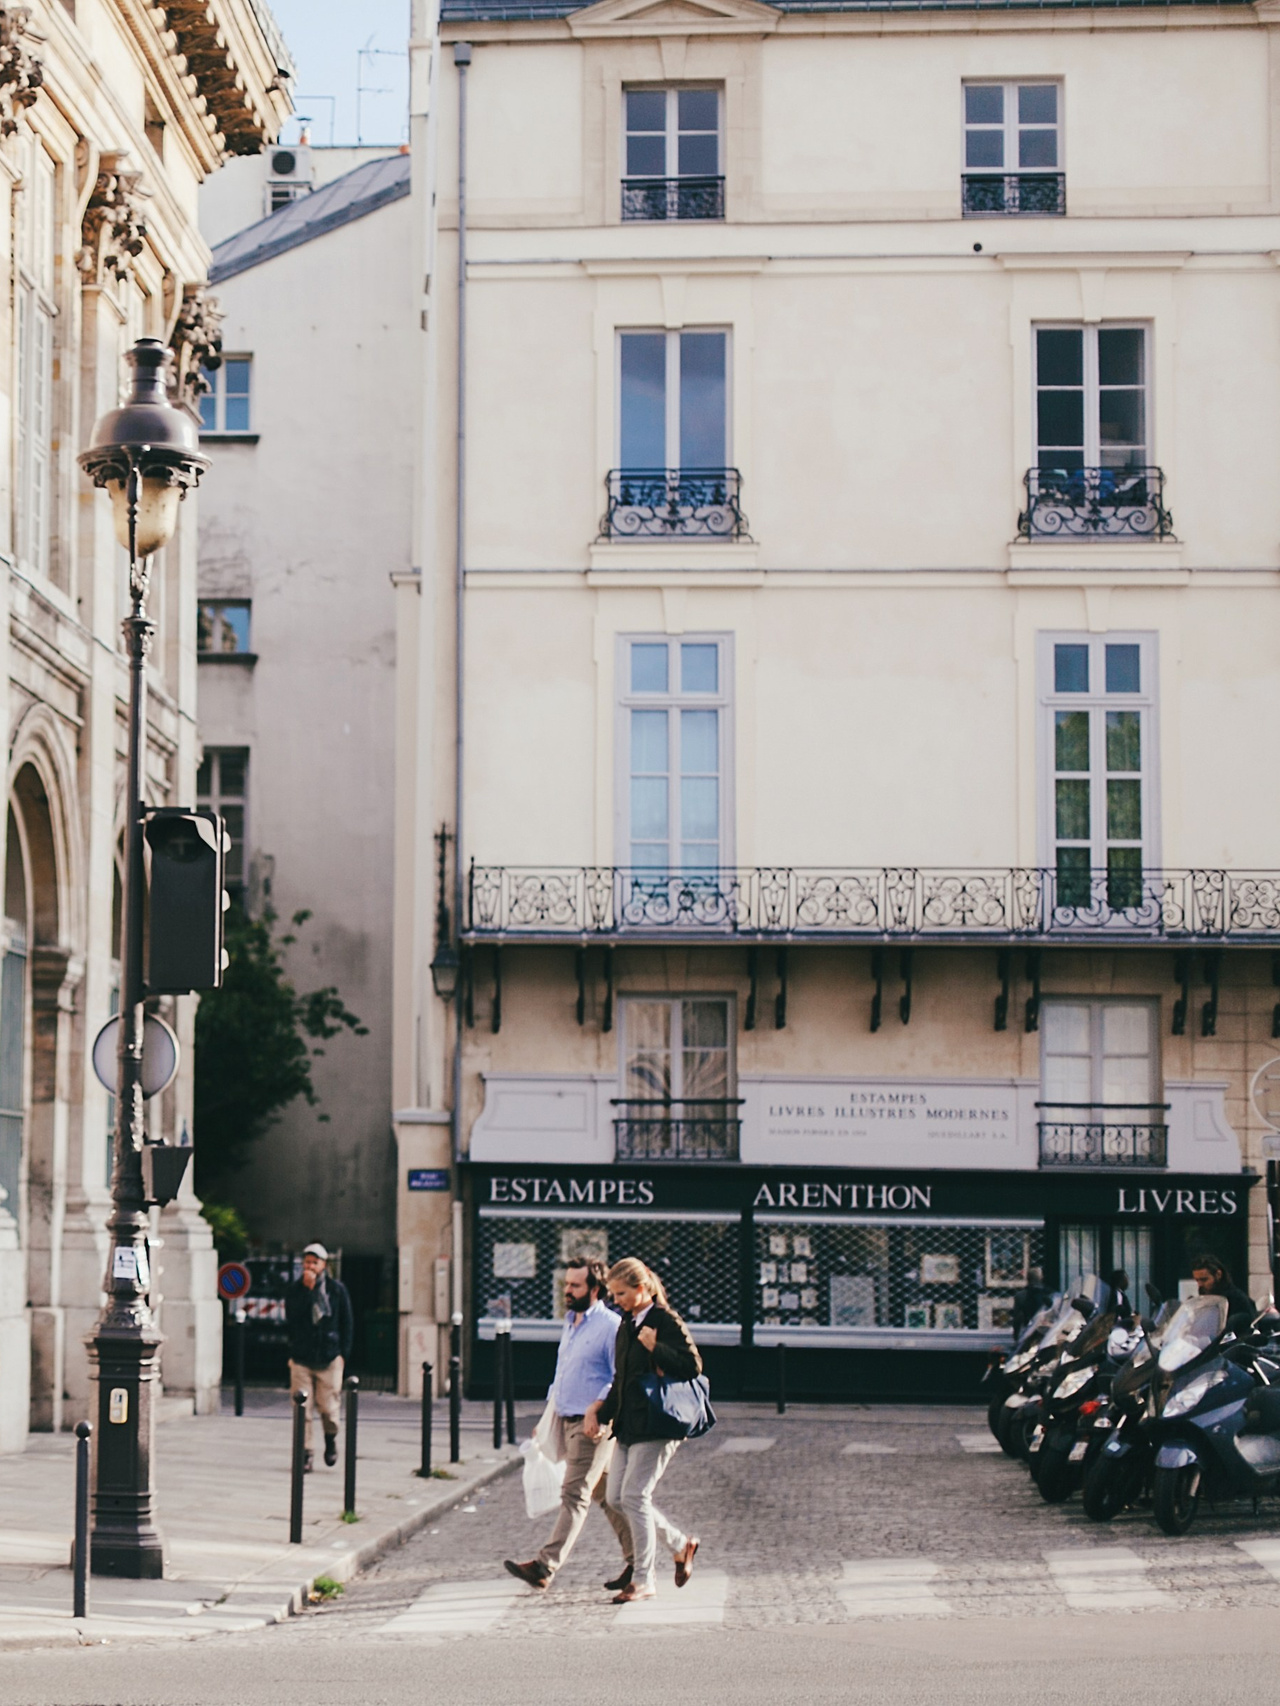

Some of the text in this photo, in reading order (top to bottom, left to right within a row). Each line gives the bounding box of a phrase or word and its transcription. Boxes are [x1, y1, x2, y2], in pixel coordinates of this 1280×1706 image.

[850, 1093, 927, 1105] ESTAMPES
[769, 1106, 825, 1117] LIVRES
[926, 1108, 1010, 1121] MODERNES
[489, 1177, 1238, 1215] ESTAMPES ARENTHON LIVRES
